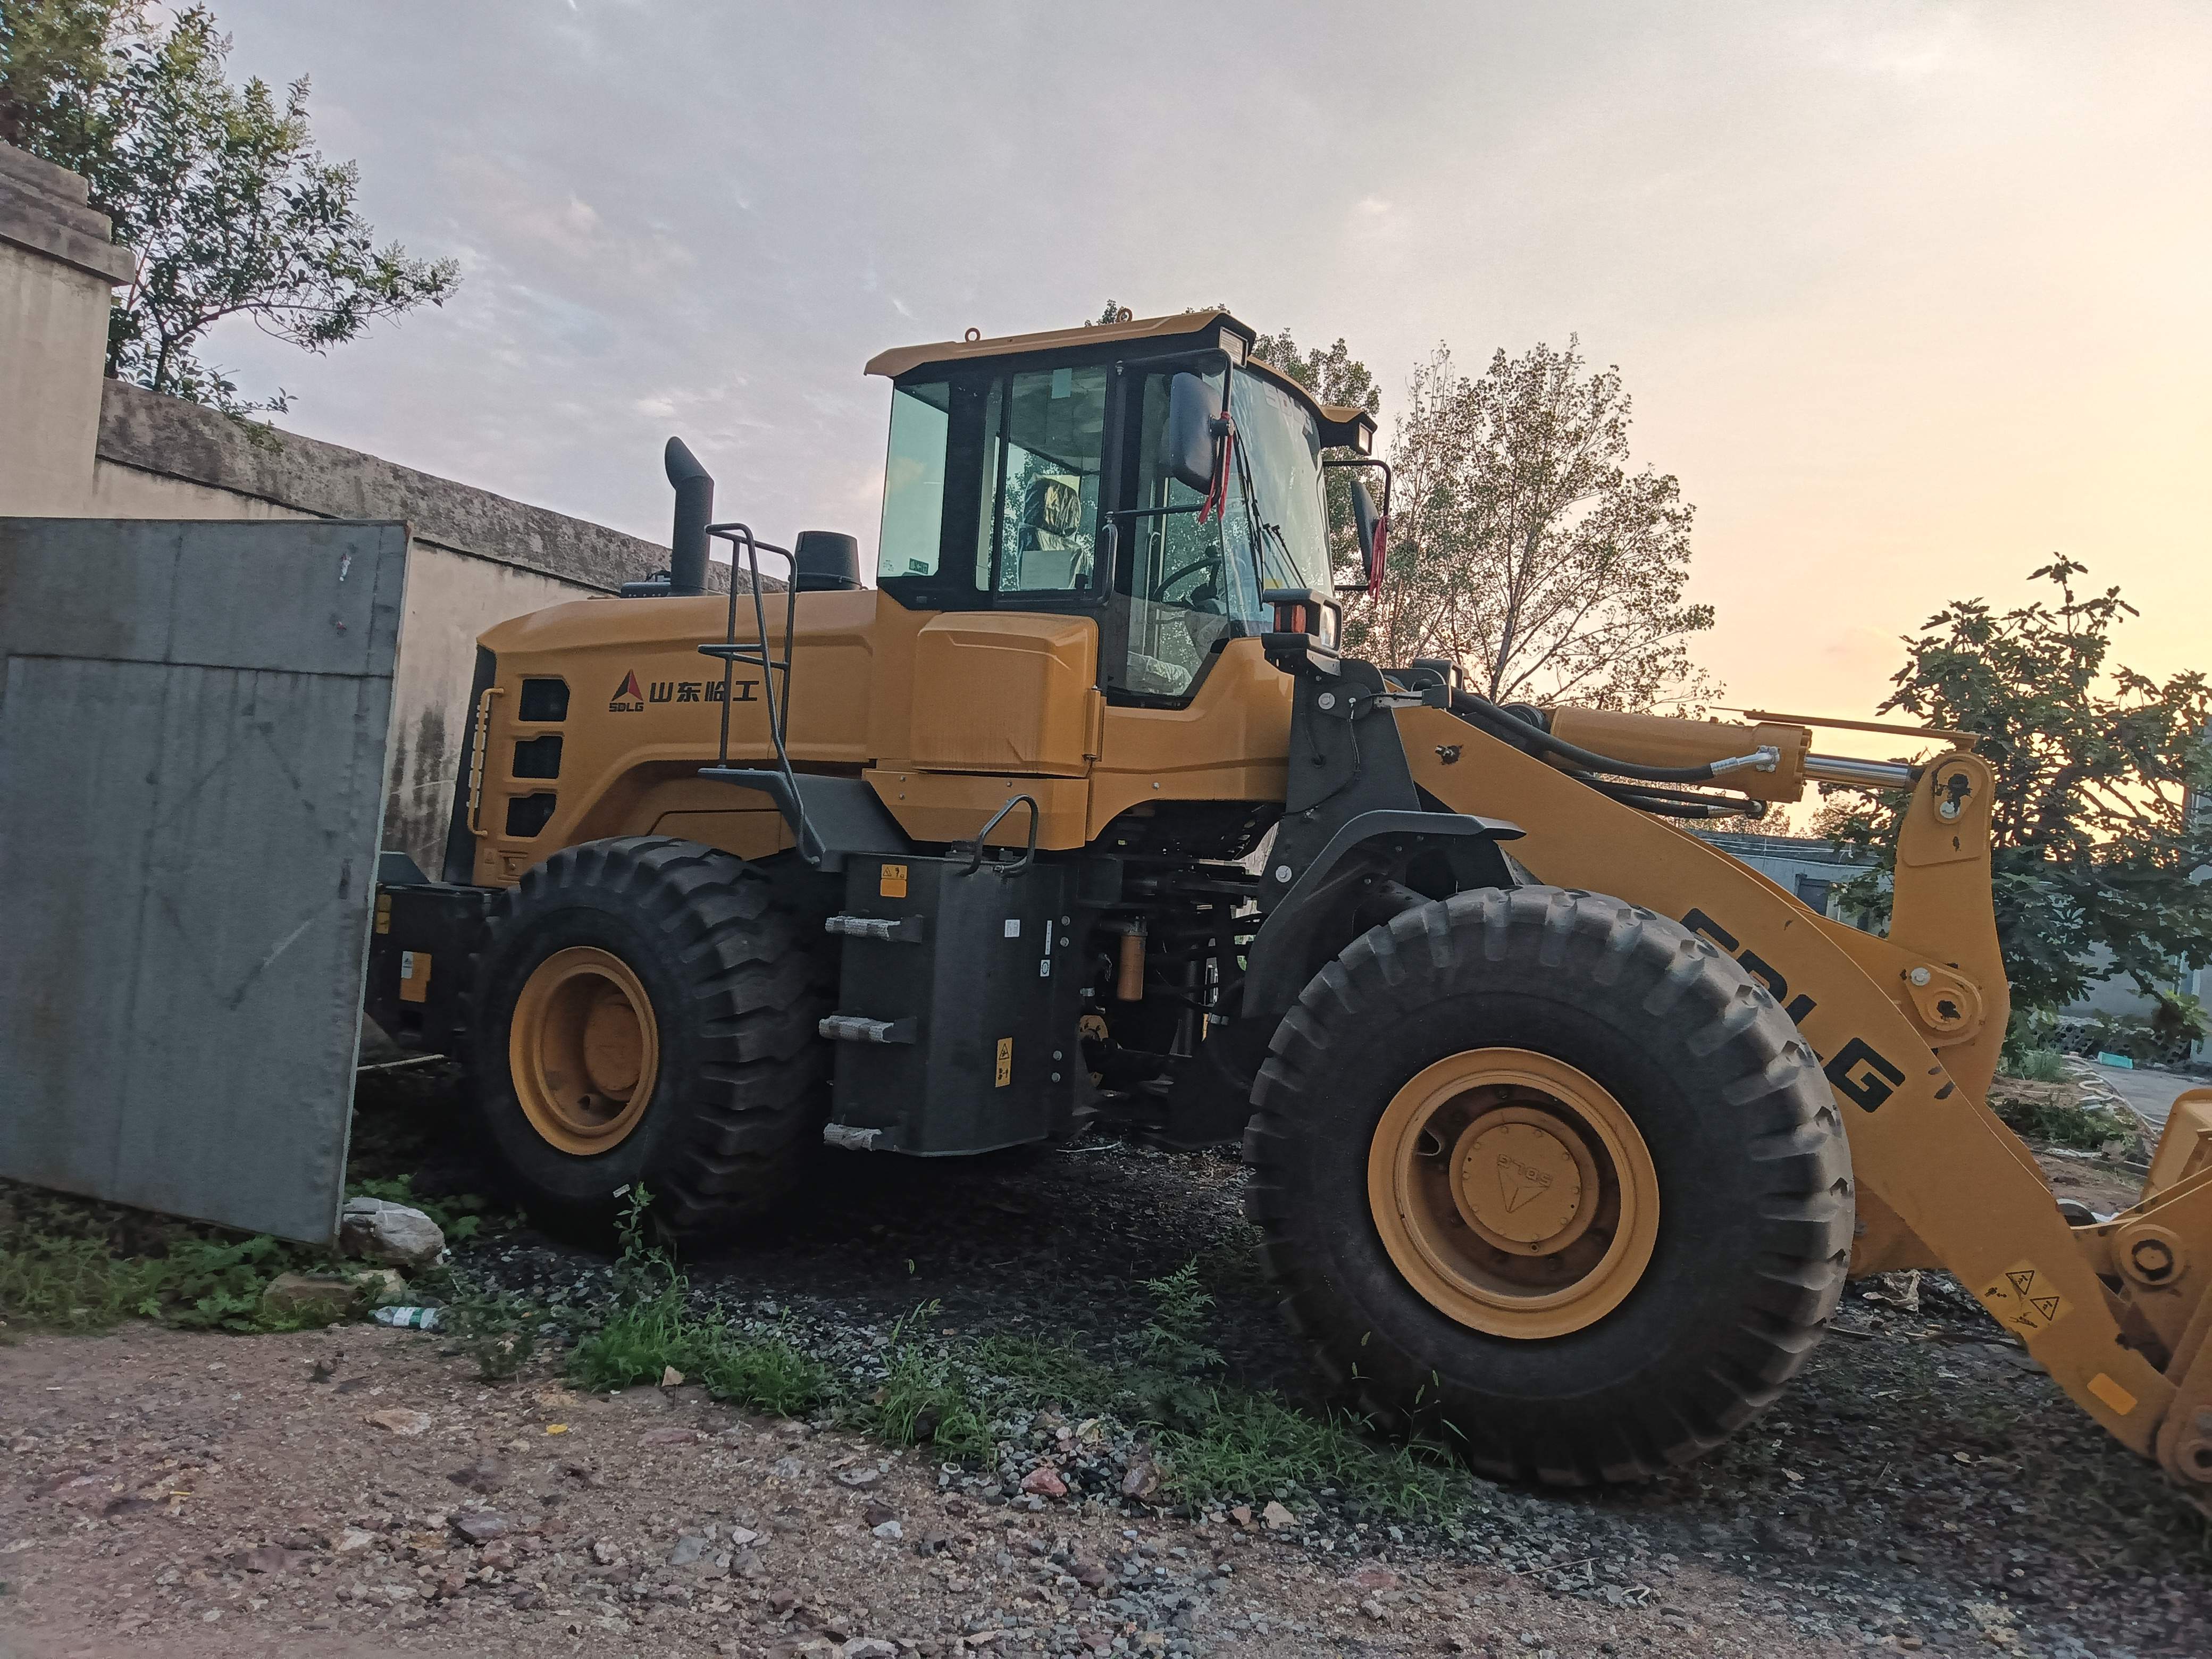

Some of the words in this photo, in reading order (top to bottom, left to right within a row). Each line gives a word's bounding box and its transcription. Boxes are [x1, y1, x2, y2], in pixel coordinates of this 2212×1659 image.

[649, 680, 760, 702] 山东临工
[608, 702, 644, 712] SDLG
[1497, 1153, 1553, 1187] SDLG
